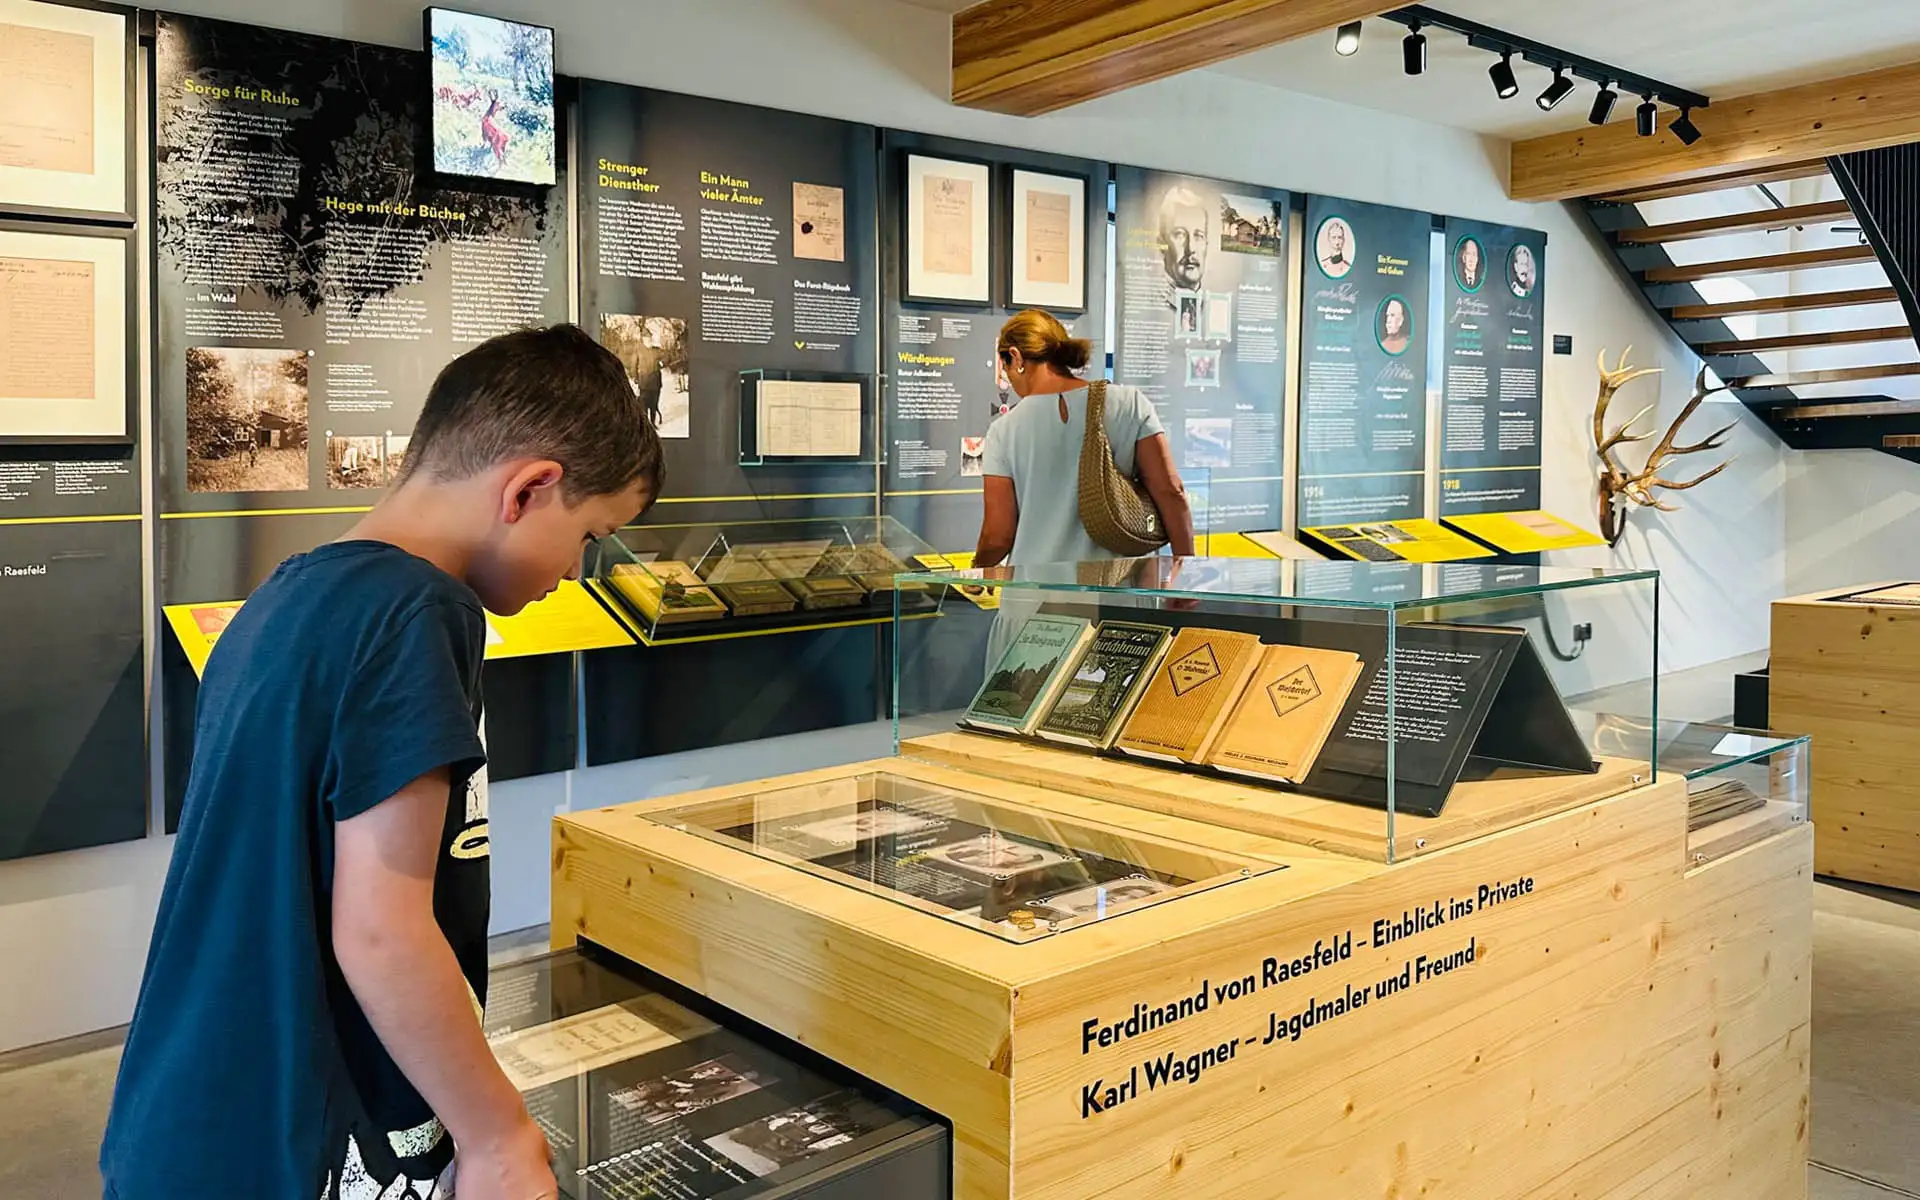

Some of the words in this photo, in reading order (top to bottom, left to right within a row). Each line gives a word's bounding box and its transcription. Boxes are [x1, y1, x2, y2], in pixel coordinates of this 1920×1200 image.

[184, 79, 230, 99] Sorge
[234, 86, 257, 100] für
[261, 89, 300, 106] Ruhe
[599, 159, 648, 176] Strenger
[600, 175, 660, 192] Dienstherr
[700, 171, 718, 185] Ein
[720, 174, 749, 188] Mann
[701, 189, 729, 202] vieler
[731, 188, 764, 206] Ämter
[326, 196, 363, 214] Hege
[367, 203, 390, 215] mit
[393, 203, 416, 216] der
[419, 205, 466, 221] Büchse
[213, 213, 229, 222] der
[231, 215, 254, 226] Jagd
[211, 293, 236, 303] Wald
[898, 352, 955, 366] Würdigungen
[4, 565, 46, 577] Raesfeld
[1081, 980, 1209, 1055] Ferdinand
[1214, 974, 1255, 1005] von
[1262, 932, 1351, 989] Raesfeld
[1373, 900, 1445, 949] Einblick
[1449, 894, 1473, 922] ins
[1478, 876, 1534, 911] Private
[1081, 1067, 1137, 1119] Karl
[1144, 1034, 1239, 1091] Wagner
[1262, 983, 1371, 1045] Jagdmaler
[1375, 962, 1410, 1000] und
[1415, 937, 1475, 985] Freund
